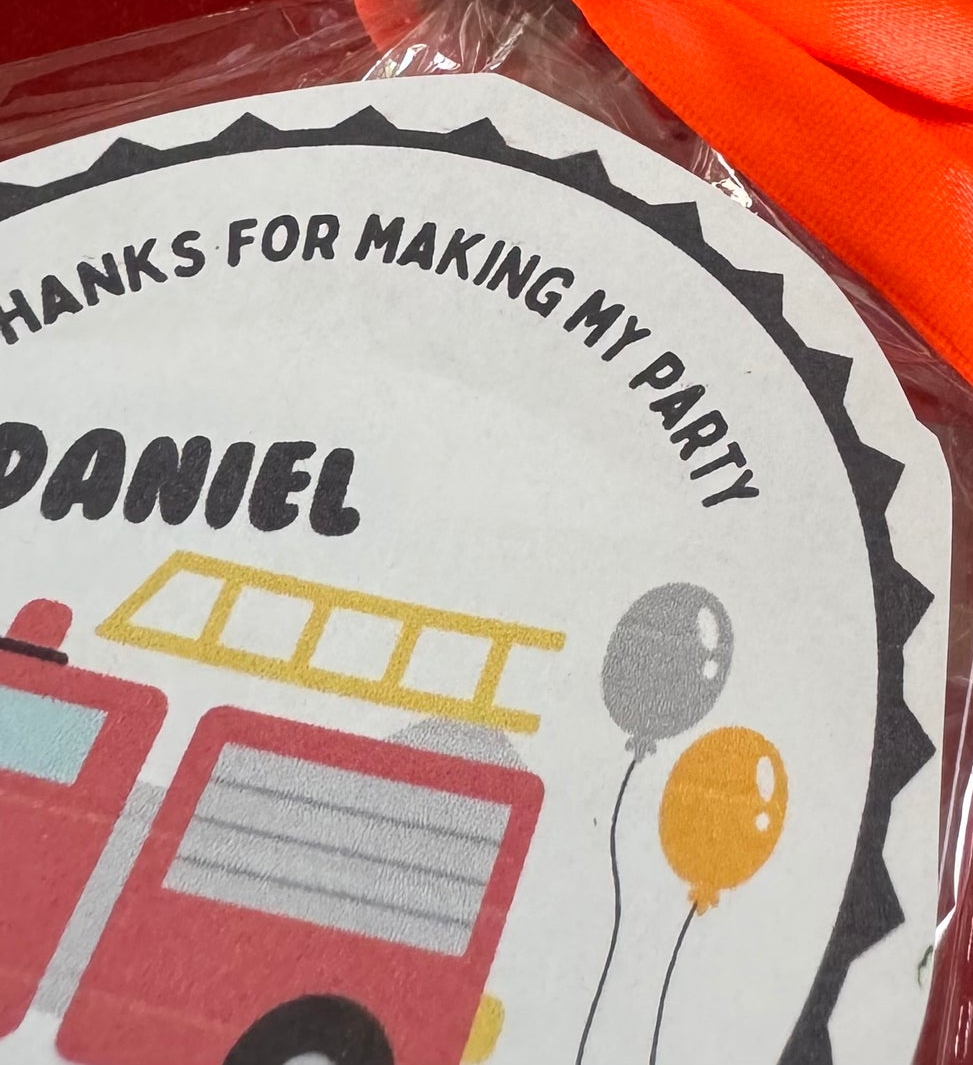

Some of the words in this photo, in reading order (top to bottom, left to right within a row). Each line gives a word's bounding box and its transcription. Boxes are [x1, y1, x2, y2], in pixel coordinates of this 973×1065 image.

[226, 213, 341, 268] FOR
[353, 213, 575, 319] MAKING
[562, 288, 652, 363] MY
[628, 350, 761, 508] PARTY
